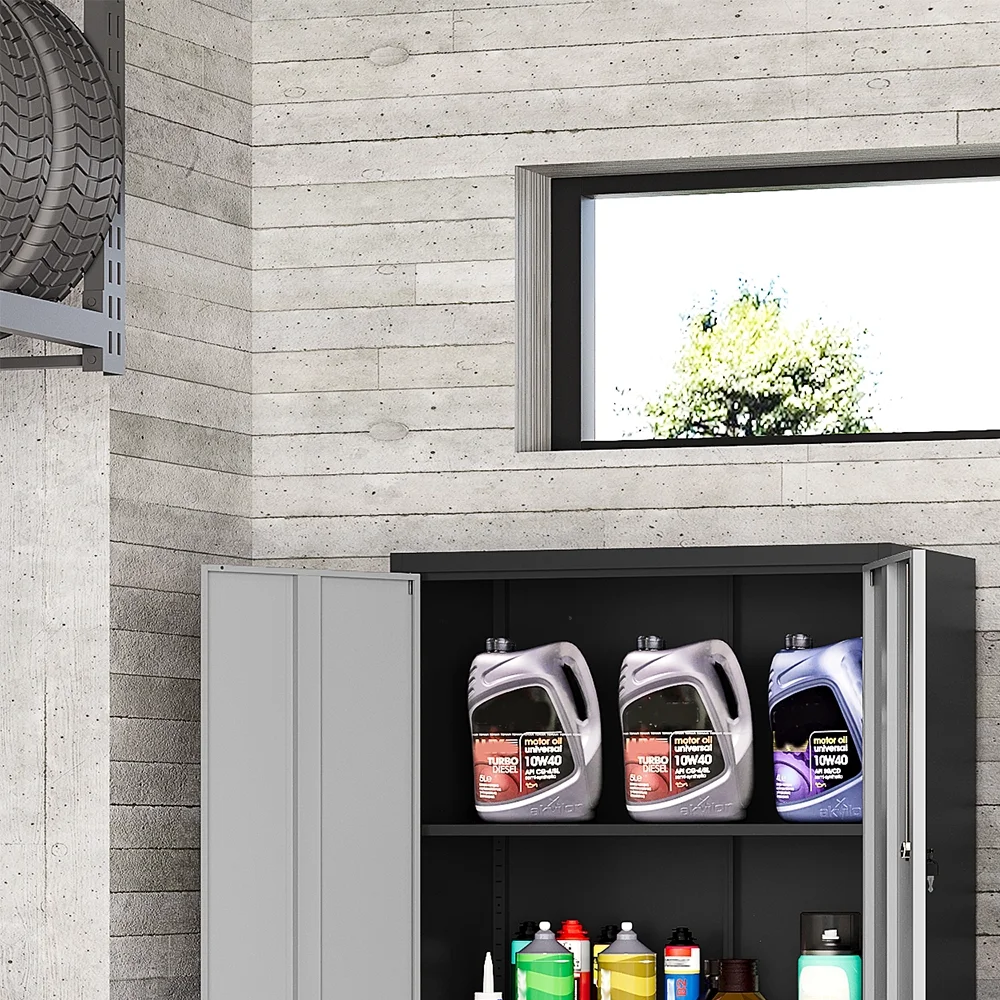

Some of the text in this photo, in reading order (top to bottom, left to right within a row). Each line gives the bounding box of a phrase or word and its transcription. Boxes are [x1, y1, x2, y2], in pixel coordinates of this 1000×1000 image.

[525, 736, 562, 746] motor oil
[674, 735, 713, 745] motor oil
[813, 736, 848, 745] motor oil
[525, 745, 563, 753] universal
[674, 744, 713, 752] universal
[813, 744, 848, 752] universal
[487, 757, 519, 766] TURBO
[525, 755, 563, 767] 10W40
[637, 756, 669, 765] TURBO
[674, 754, 713, 766] 10W40
[813, 754, 849, 766] 10W40
[492, 765, 519, 774] DIESEL
[642, 764, 669, 773] DIESEL
